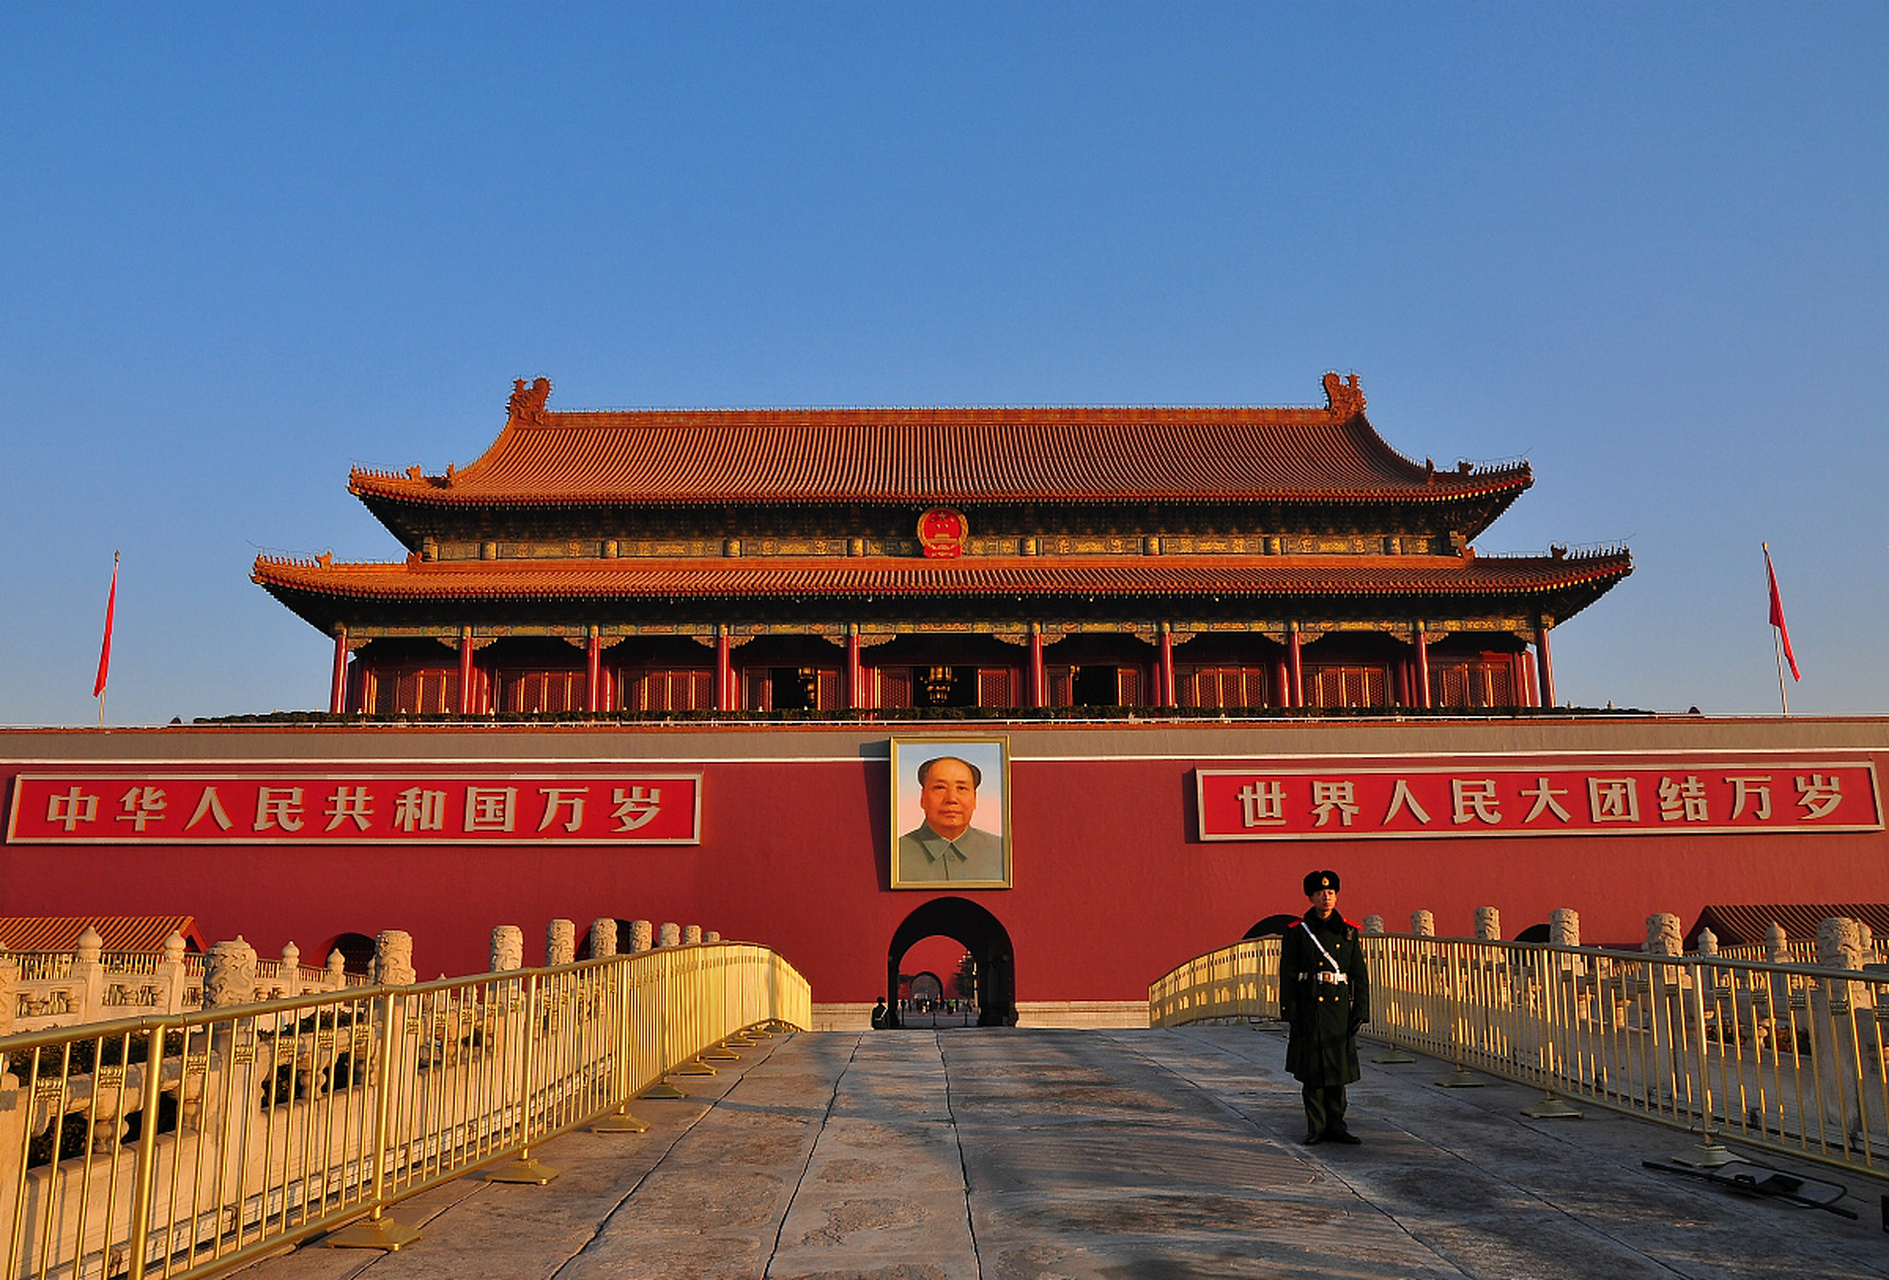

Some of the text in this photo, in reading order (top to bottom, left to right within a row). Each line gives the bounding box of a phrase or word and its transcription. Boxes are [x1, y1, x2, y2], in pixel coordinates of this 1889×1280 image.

[46, 786, 662, 832] 中华人民共和国万岁
[1237, 774, 1844, 828] 世界人民大团结万岁
